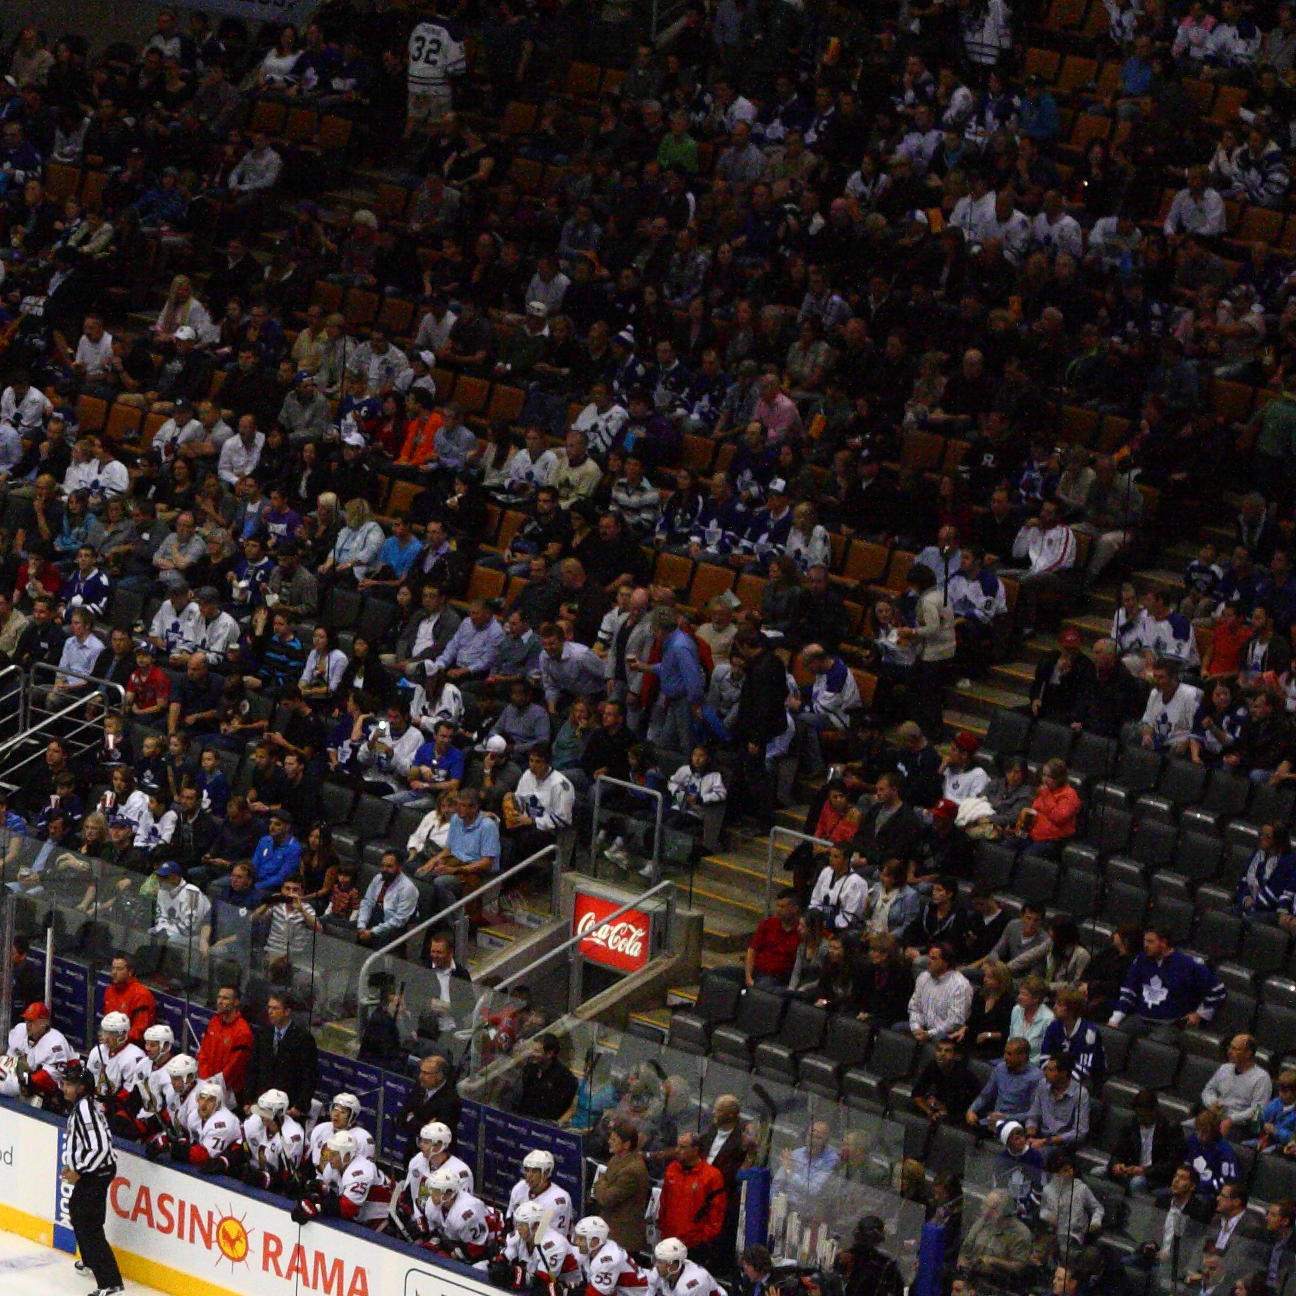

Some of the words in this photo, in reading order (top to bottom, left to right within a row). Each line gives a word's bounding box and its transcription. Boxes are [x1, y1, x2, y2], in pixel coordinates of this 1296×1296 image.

[411, 35, 441, 65] 32
[211, 1137, 226, 1151] 71
[350, 1182, 368, 1196] 25
